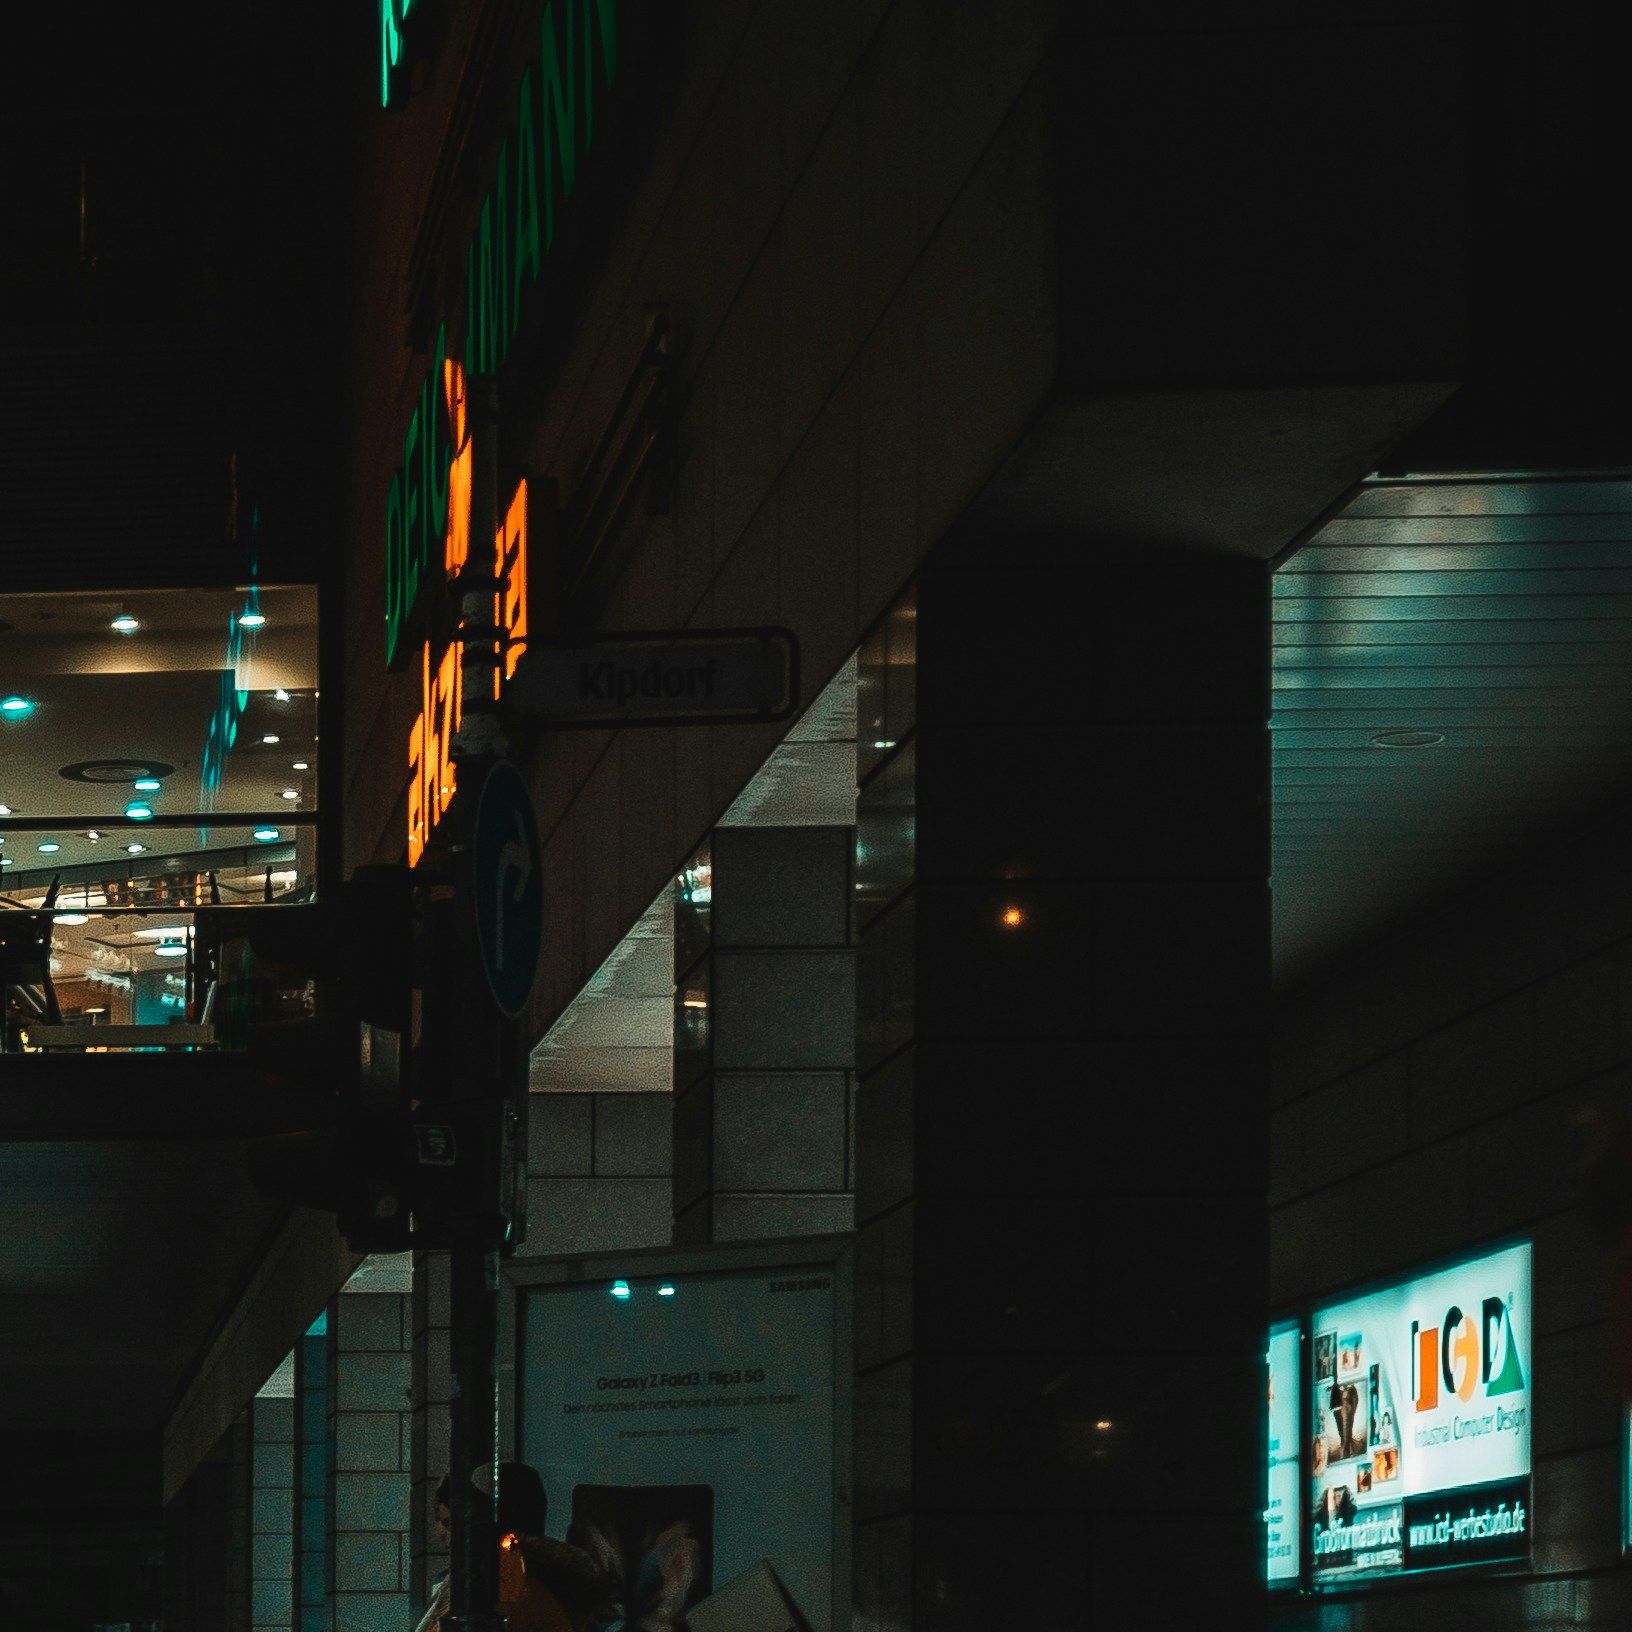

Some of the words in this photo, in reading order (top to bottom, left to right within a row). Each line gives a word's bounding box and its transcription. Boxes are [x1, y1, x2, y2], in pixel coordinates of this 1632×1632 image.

[578, 658, 717, 705] Kipdorf
[596, 1374, 647, 1391] Galaxy
[648, 1372, 658, 1387] Z
[660, 1370, 700, 1387] Fold3
[707, 1368, 741, 1387] Flip3
[743, 1367, 766, 1382] 5G
[1496, 1405, 1526, 1437] Design
